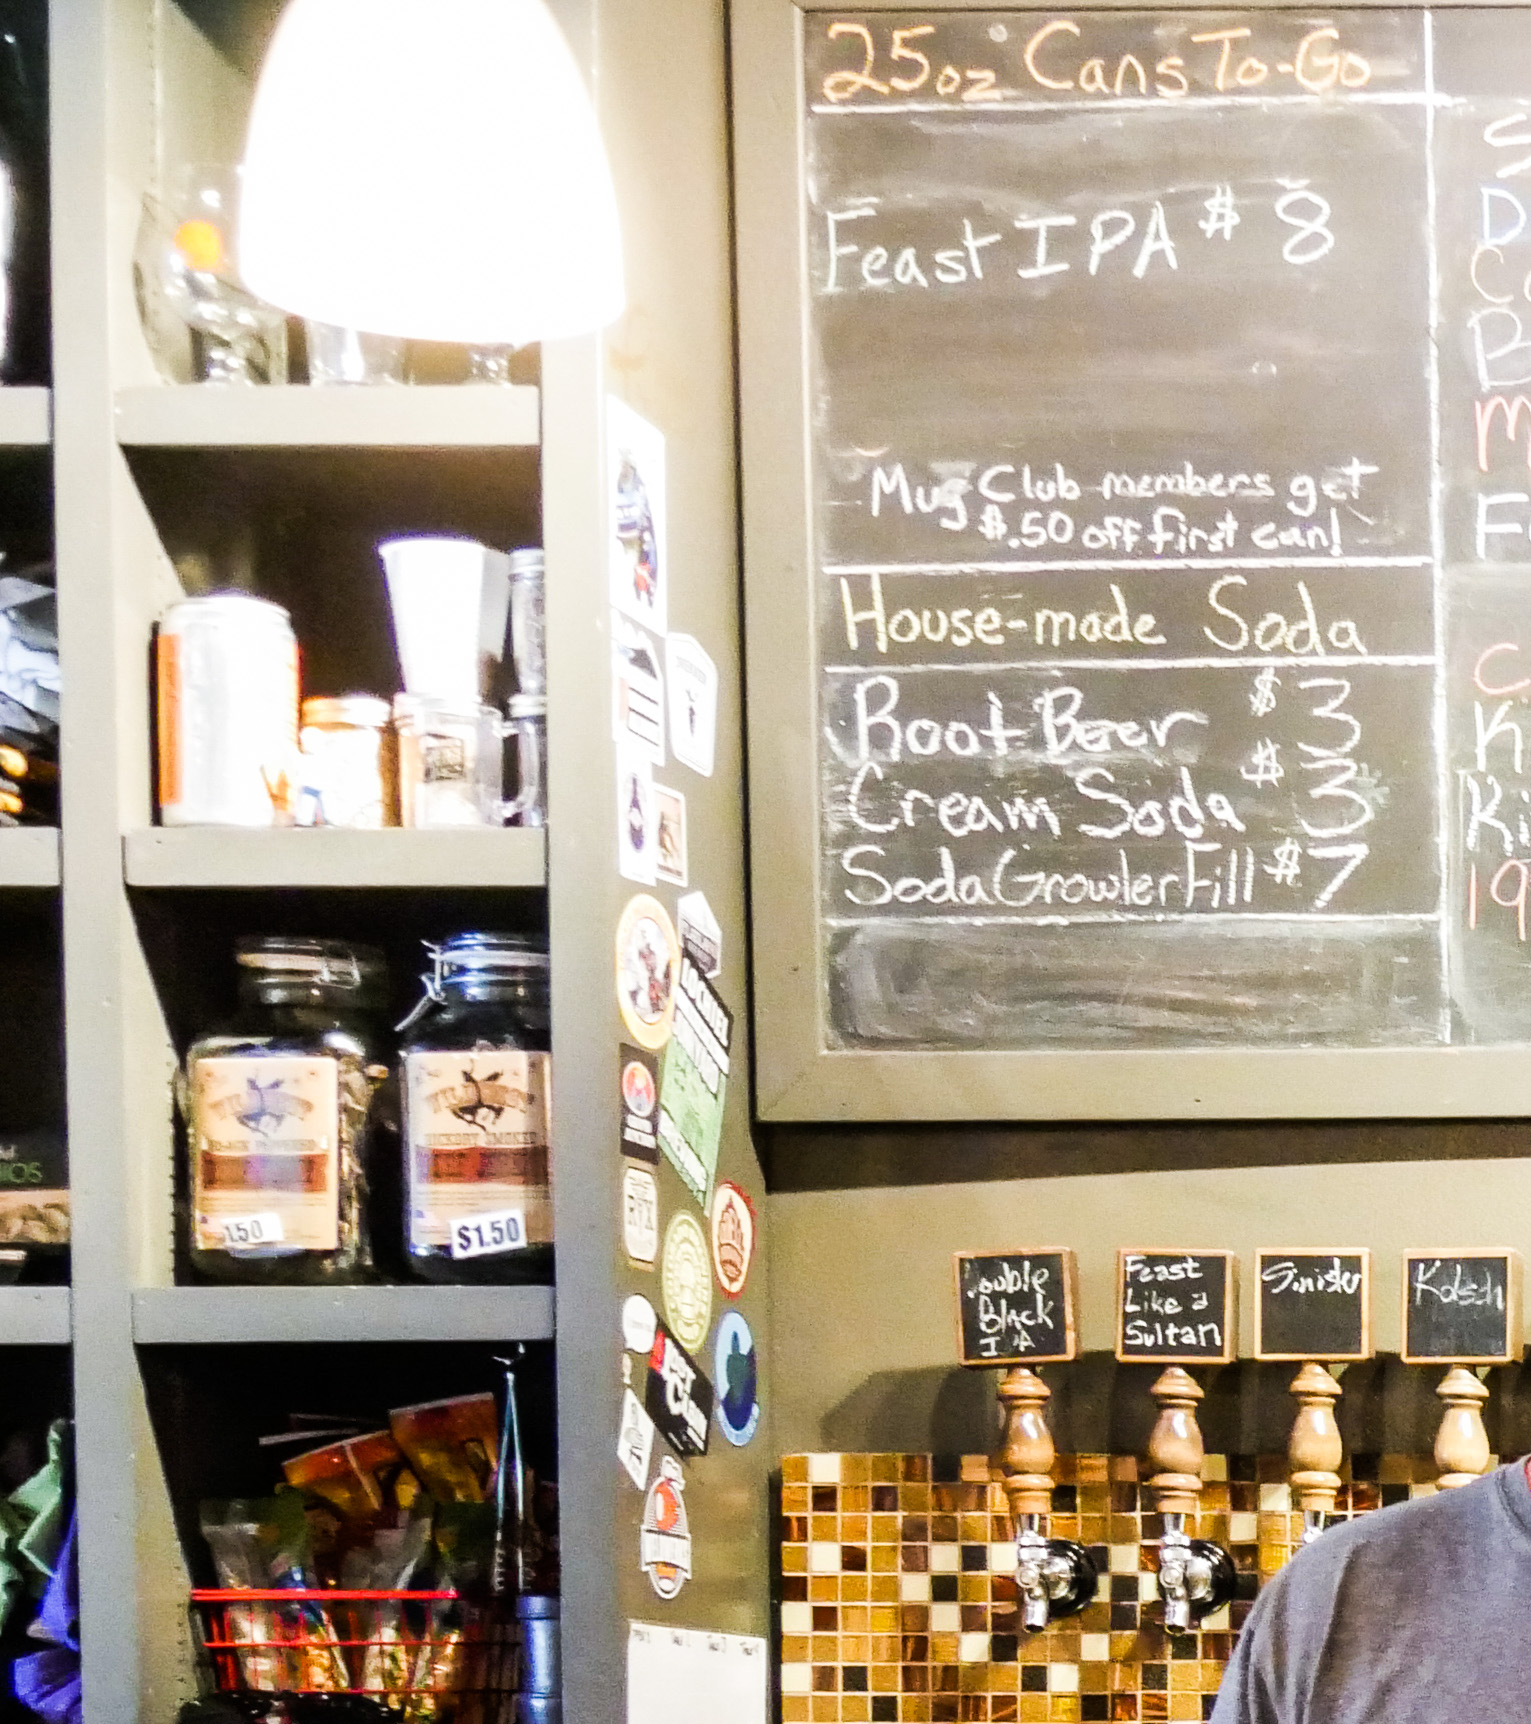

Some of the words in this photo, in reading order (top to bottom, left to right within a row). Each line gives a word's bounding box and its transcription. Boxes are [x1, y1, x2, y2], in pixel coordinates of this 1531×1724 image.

[1024, 20, 1188, 98] Cans
[1191, 27, 1373, 93] To-Go
[824, 197, 1004, 292] Feast
[1015, 201, 1179, 280] IPA
[870, 467, 968, 531] Mug
[979, 462, 1084, 502] Club
[1102, 466, 1275, 498] members
[1286, 457, 1379, 516] get
[1083, 513, 1140, 551] off
[1148, 509, 1238, 552] first
[1202, 574, 1368, 656] Soda
[1040, 685, 1210, 759] Beer
[846, 762, 1063, 839] Cream
[1073, 765, 1246, 839] Soda
[457, 1217, 521, 1252] $1.50
[1124, 1256, 1202, 1282] Feast
[1124, 1289, 1182, 1315] Like
[1124, 1321, 1222, 1346] Sultan
